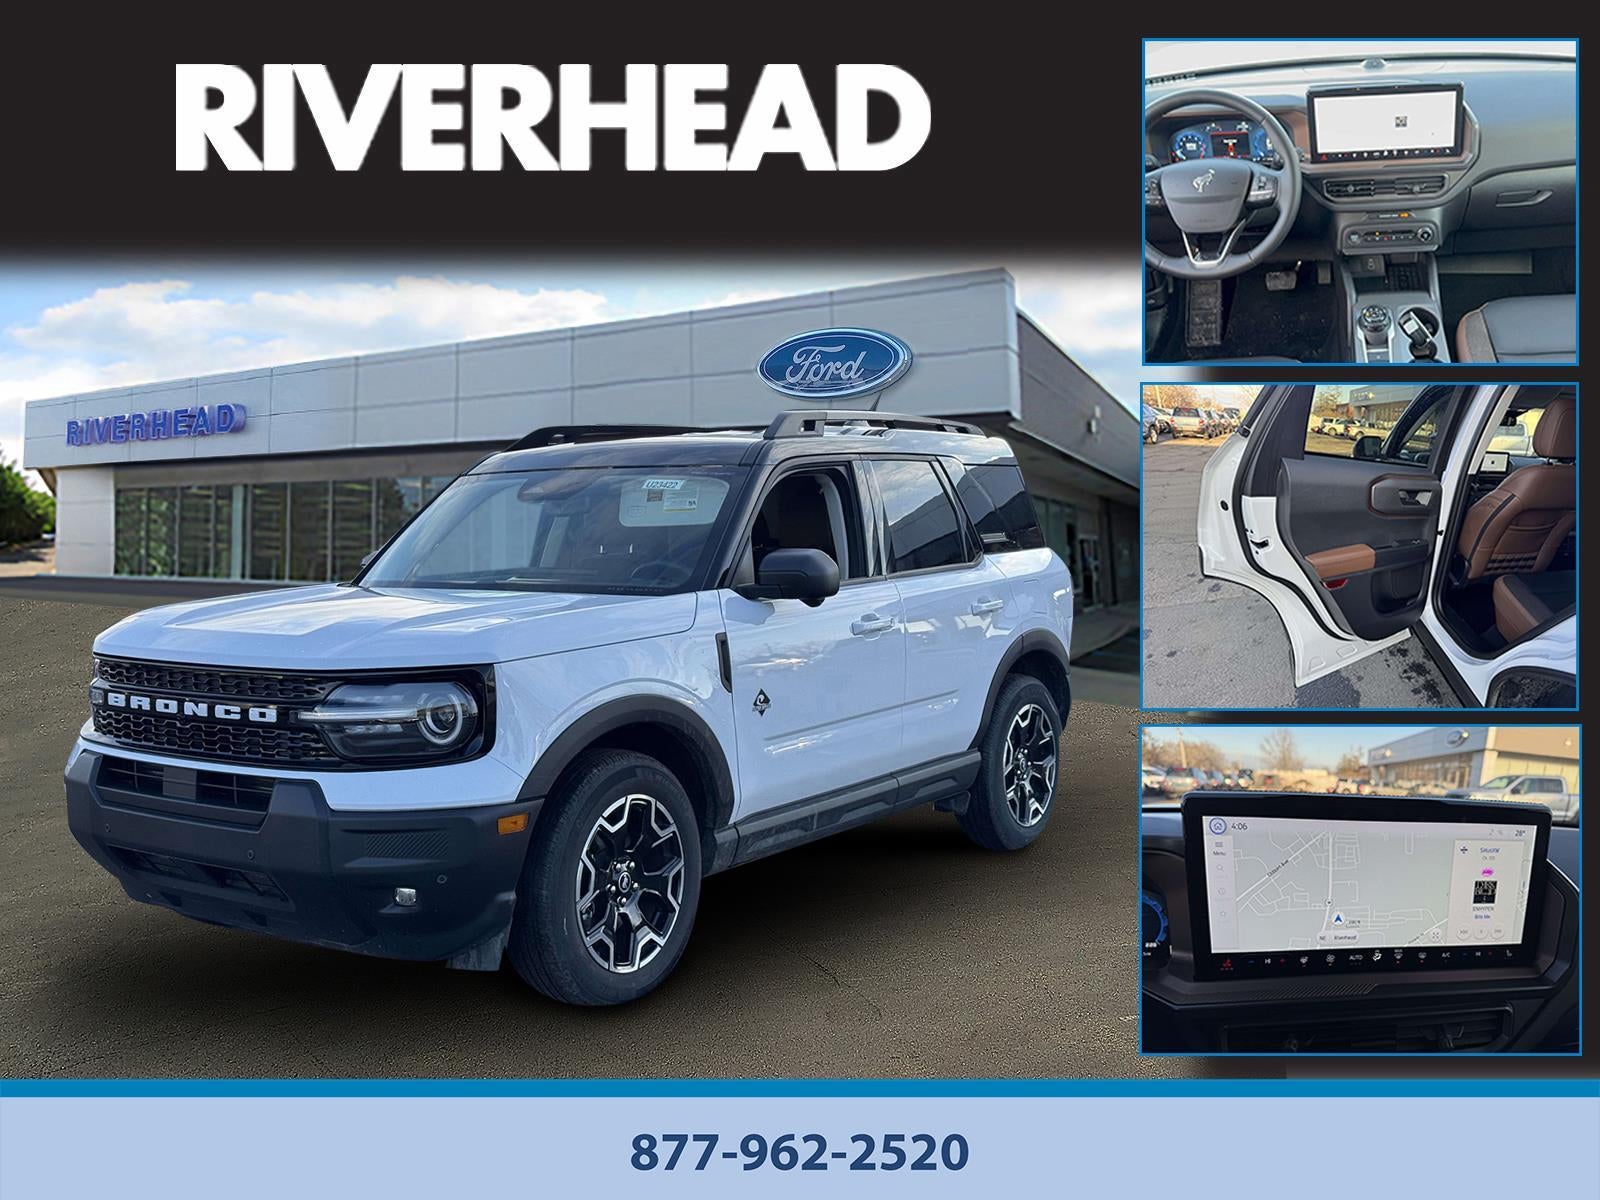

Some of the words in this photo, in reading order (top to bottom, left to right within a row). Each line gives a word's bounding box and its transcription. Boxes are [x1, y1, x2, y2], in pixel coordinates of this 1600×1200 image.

[785, 344, 867, 384] Ford
[66, 403, 246, 447] RIVERHEAD
[107, 692, 278, 723] BRONCO
[1231, 822, 1249, 831] 4:06
